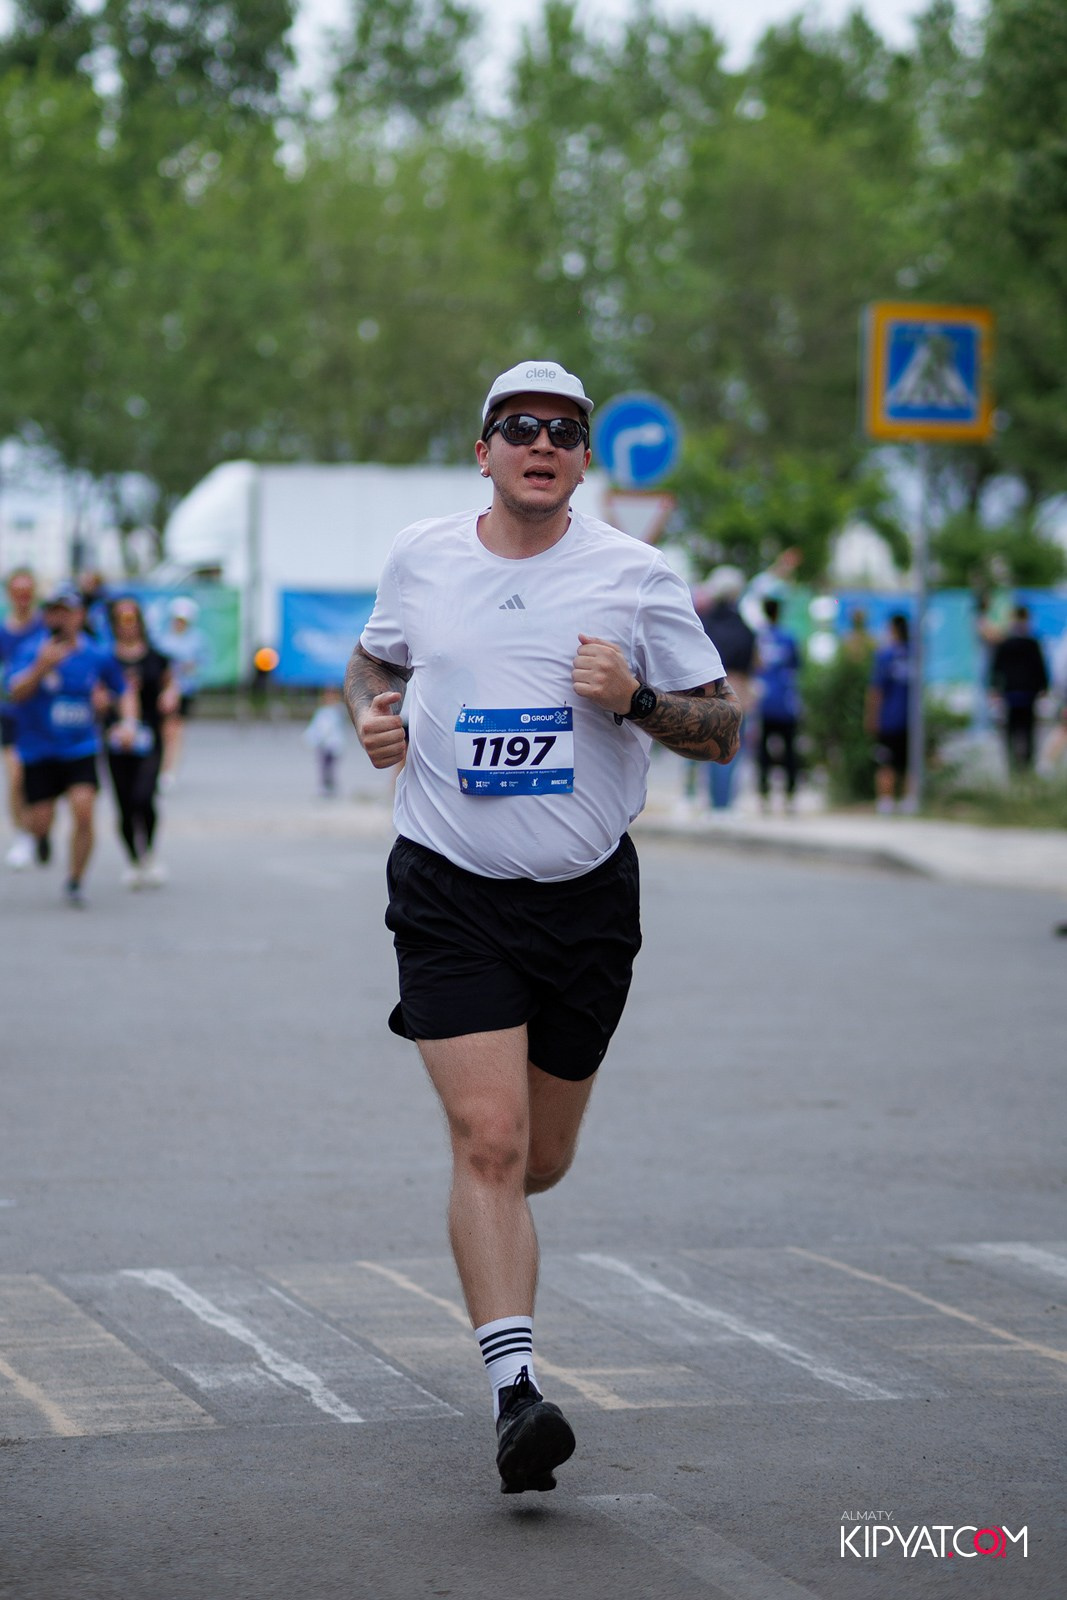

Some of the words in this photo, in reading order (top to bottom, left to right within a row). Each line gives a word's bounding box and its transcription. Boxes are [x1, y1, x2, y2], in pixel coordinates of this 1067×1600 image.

[458, 712, 466, 723] 5
[467, 715, 484, 724] KM
[531, 714, 554, 722] GROUP
[472, 736, 557, 766] 1197
